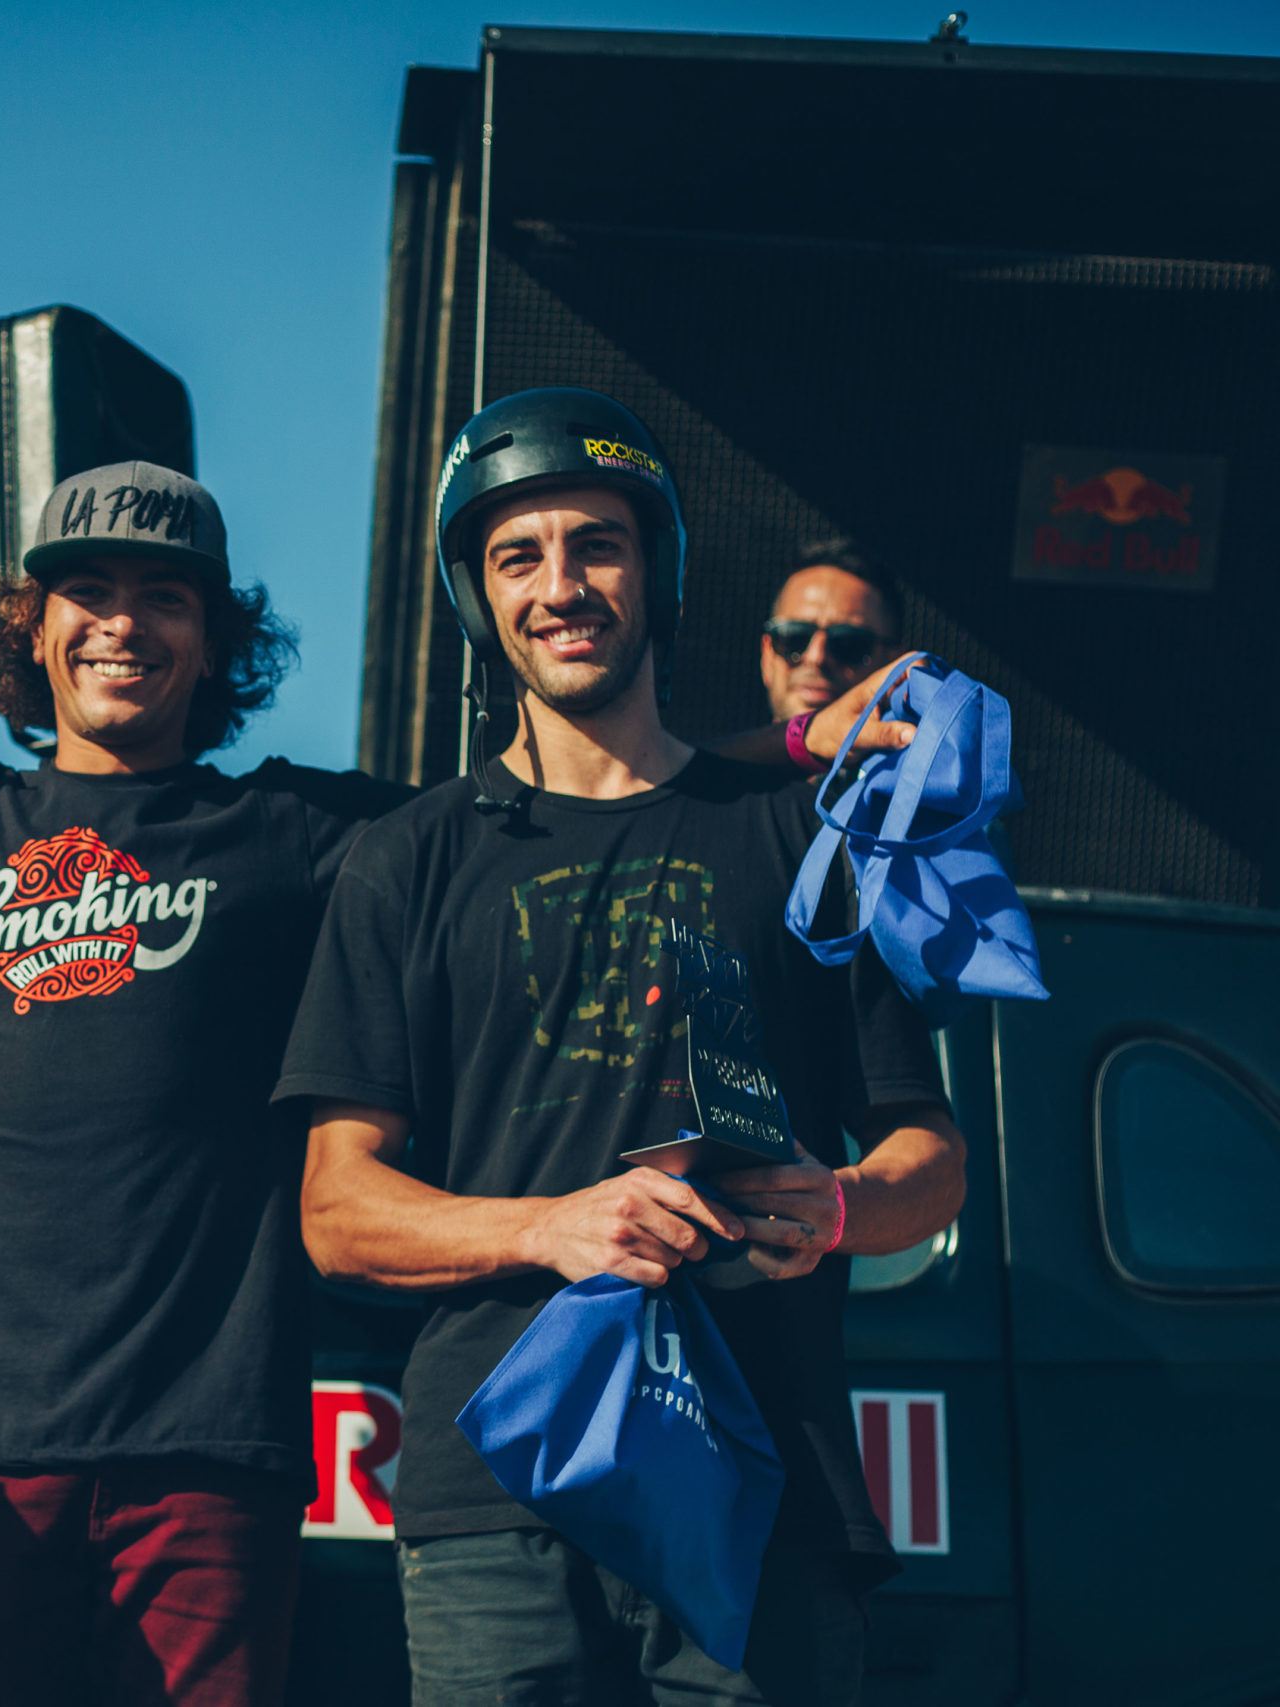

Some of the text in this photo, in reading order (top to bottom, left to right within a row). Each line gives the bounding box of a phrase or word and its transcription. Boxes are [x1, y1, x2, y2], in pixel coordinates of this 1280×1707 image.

[60, 486, 98, 538] LA
[1033, 526, 1200, 575] Red Bull
[5, 941, 127, 989] ROLL WITH IT
